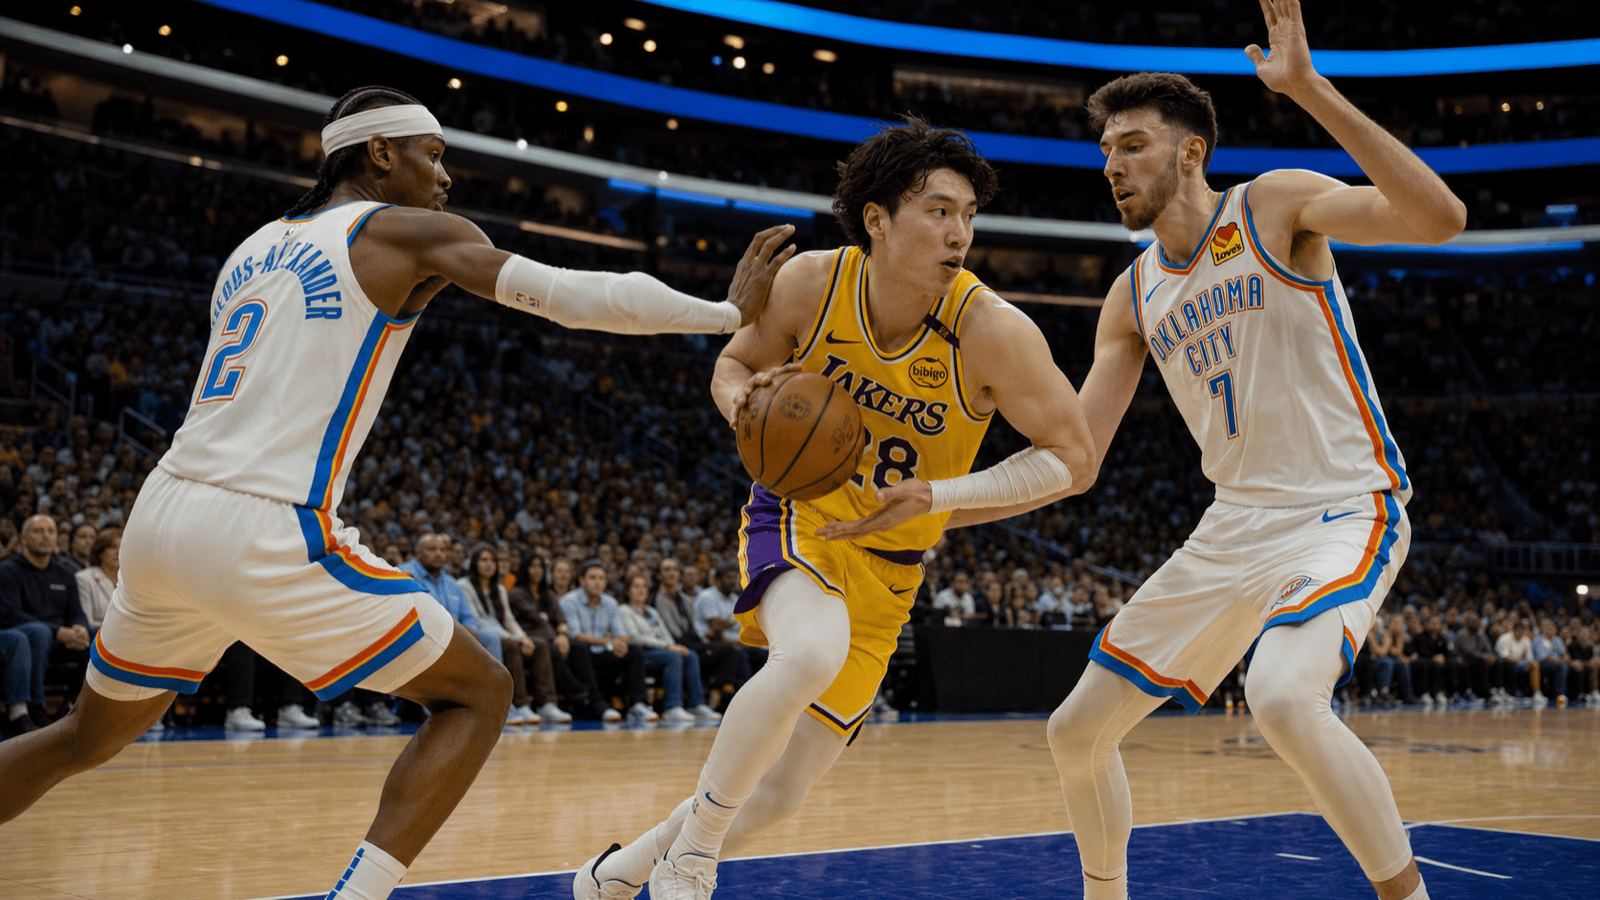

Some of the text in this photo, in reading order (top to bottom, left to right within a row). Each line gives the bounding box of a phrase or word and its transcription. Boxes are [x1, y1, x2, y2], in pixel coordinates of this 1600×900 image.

[210, 241, 343, 332] EOUS-ALEXANDER
[1214, 243, 1242, 262] Love's
[196, 298, 269, 406] 2
[1149, 274, 1265, 364] OKLAHOMA
[1184, 322, 1237, 377] CITY
[912, 364, 946, 381] bibigo
[1206, 368, 1240, 441] 7
